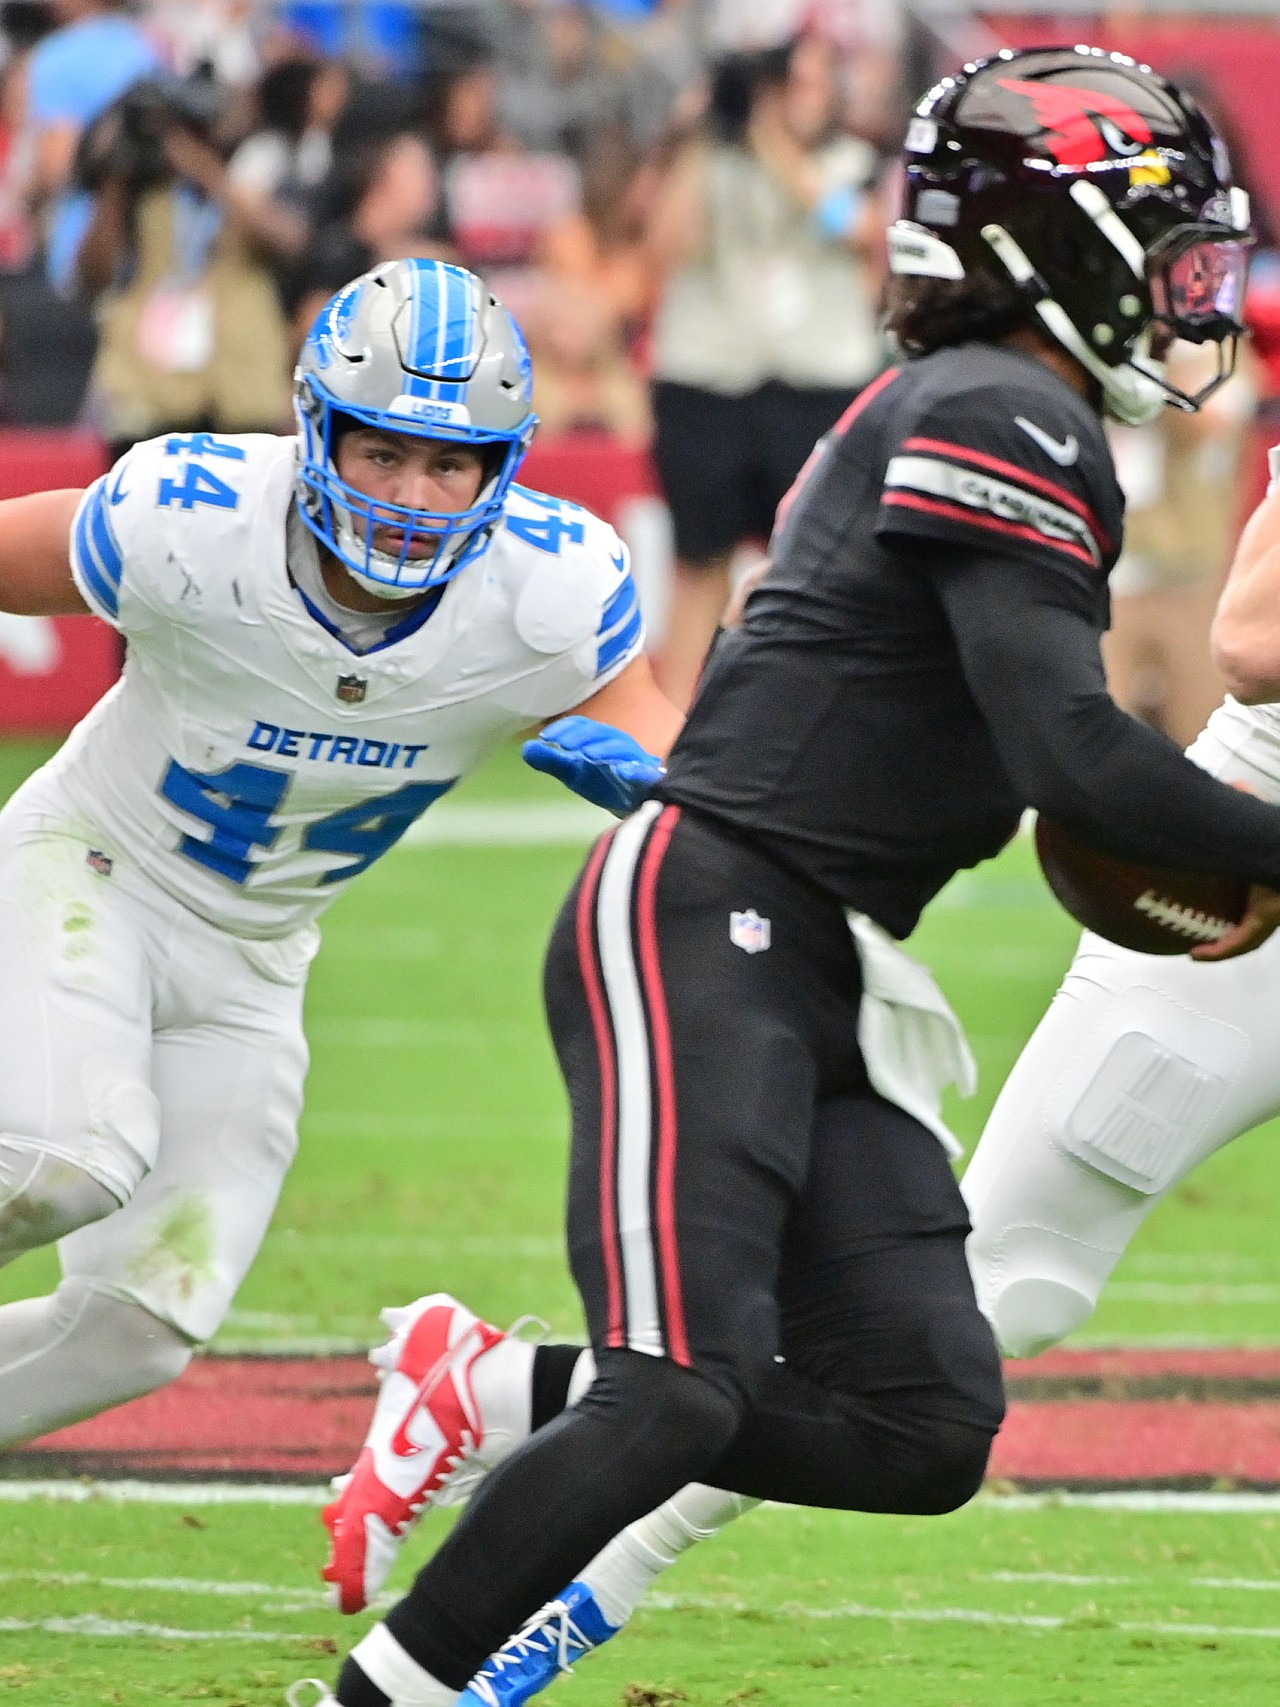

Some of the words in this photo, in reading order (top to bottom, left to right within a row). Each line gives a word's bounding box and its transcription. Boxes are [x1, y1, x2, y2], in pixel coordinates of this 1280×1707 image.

[155, 431, 247, 513] 44
[246, 719, 429, 769] DETROIT
[155, 754, 464, 888] 44
